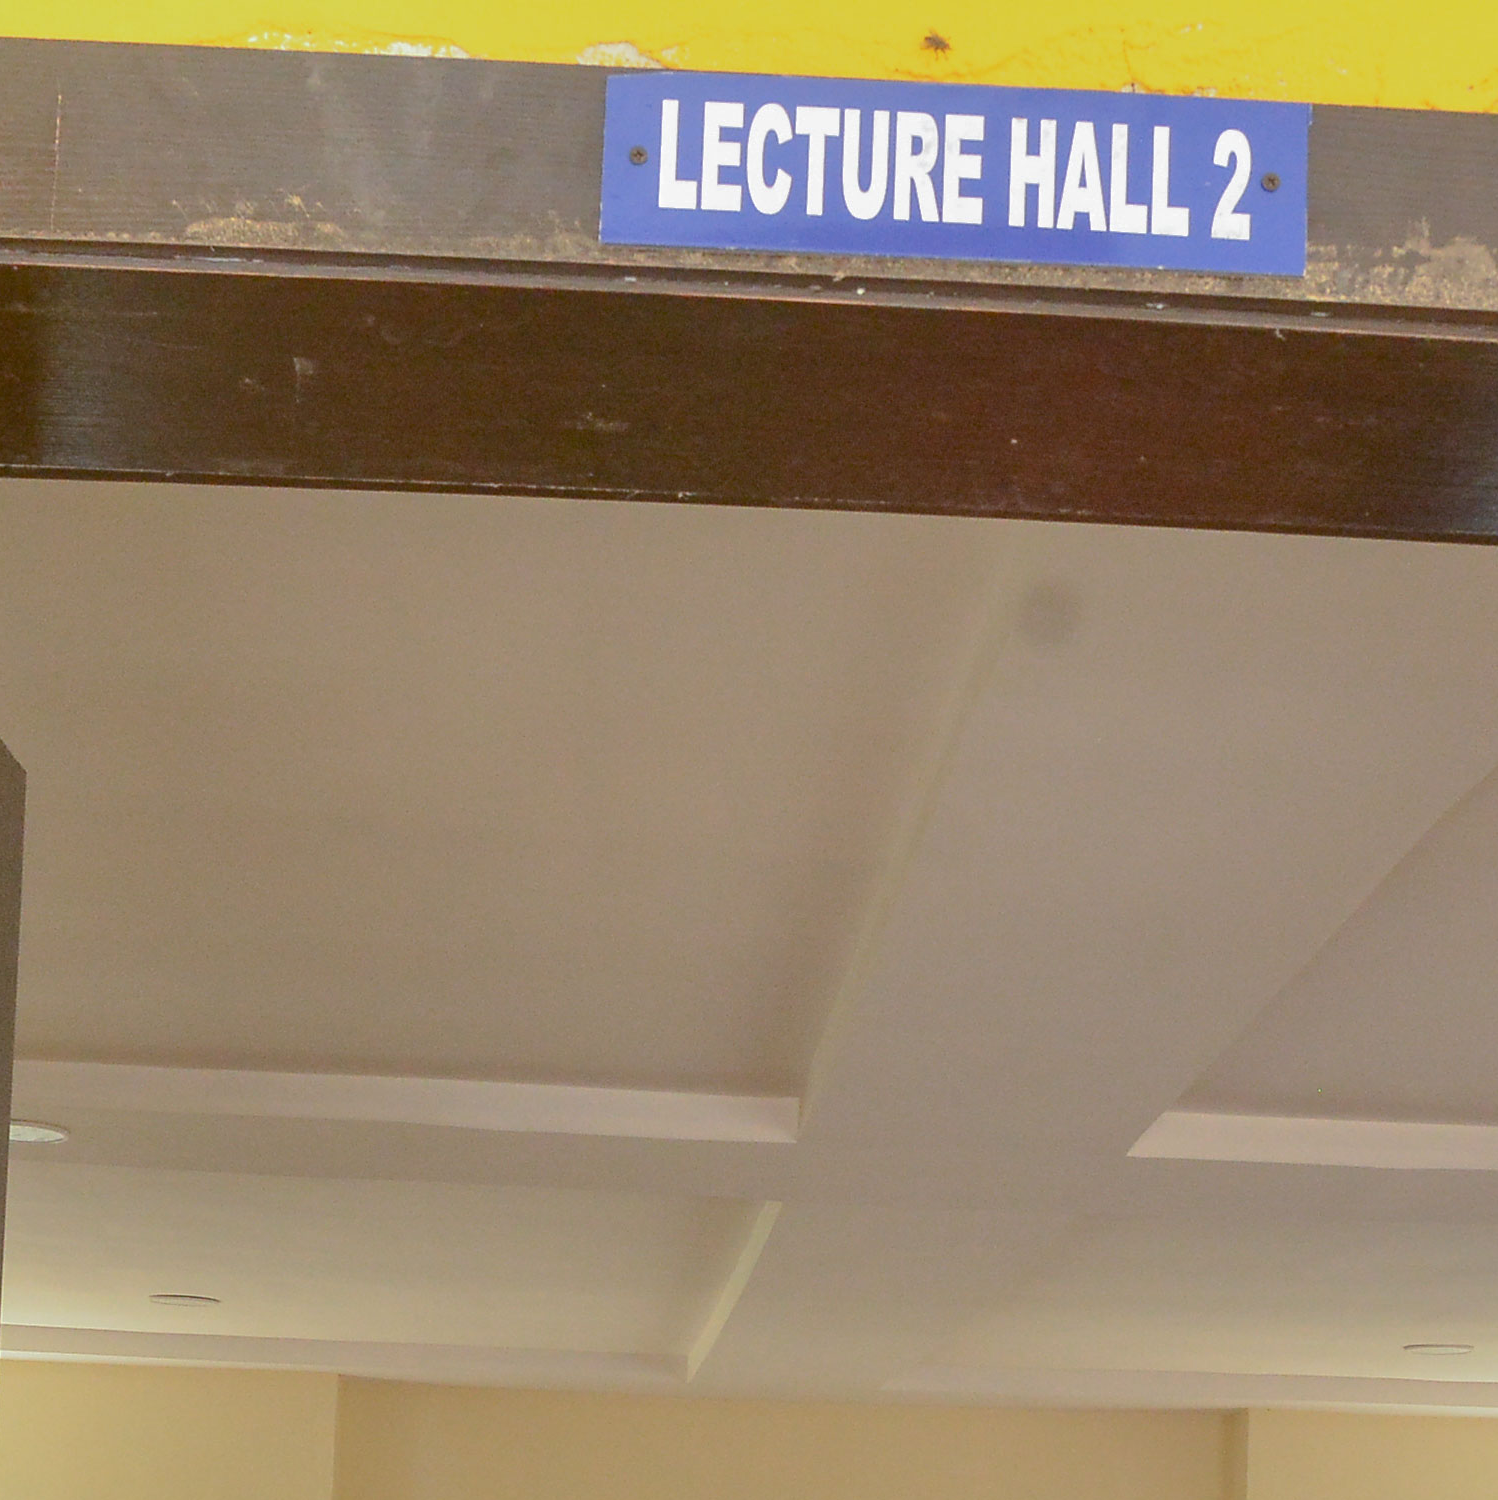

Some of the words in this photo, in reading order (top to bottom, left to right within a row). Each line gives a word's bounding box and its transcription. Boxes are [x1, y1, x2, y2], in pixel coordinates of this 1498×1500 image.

[657, 98, 986, 226] LECTURE
[1007, 117, 1191, 238] HALL
[1210, 128, 1253, 241] 2
